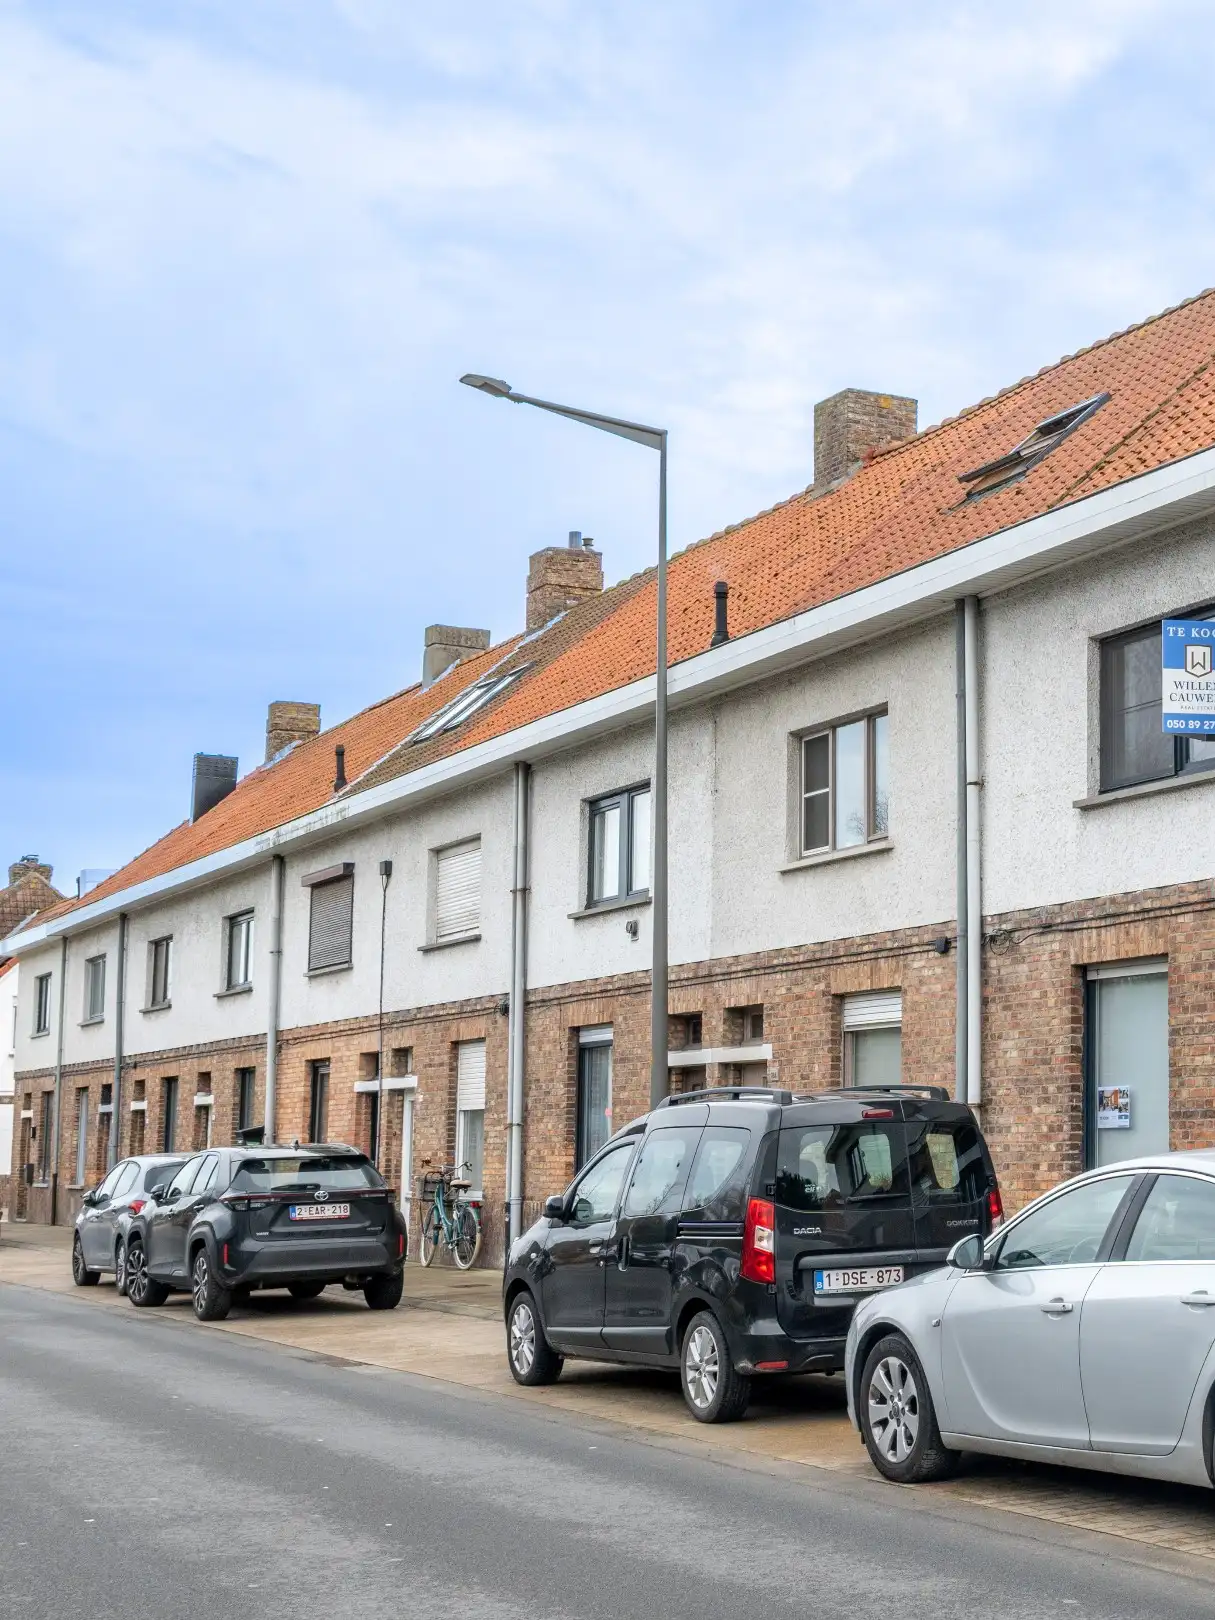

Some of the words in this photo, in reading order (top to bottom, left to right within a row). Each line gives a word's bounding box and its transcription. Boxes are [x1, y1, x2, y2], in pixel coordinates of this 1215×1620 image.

[1167, 626, 1185, 637] TE
[1166, 719, 1186, 729] 050
[1188, 720, 1200, 729] 89
[1203, 720, 1215, 730] 27
[793, 1227, 822, 1235] DACIA
[816, 1281, 823, 1289] B
[825, 1269, 901, 1287] 1-DSE-873
